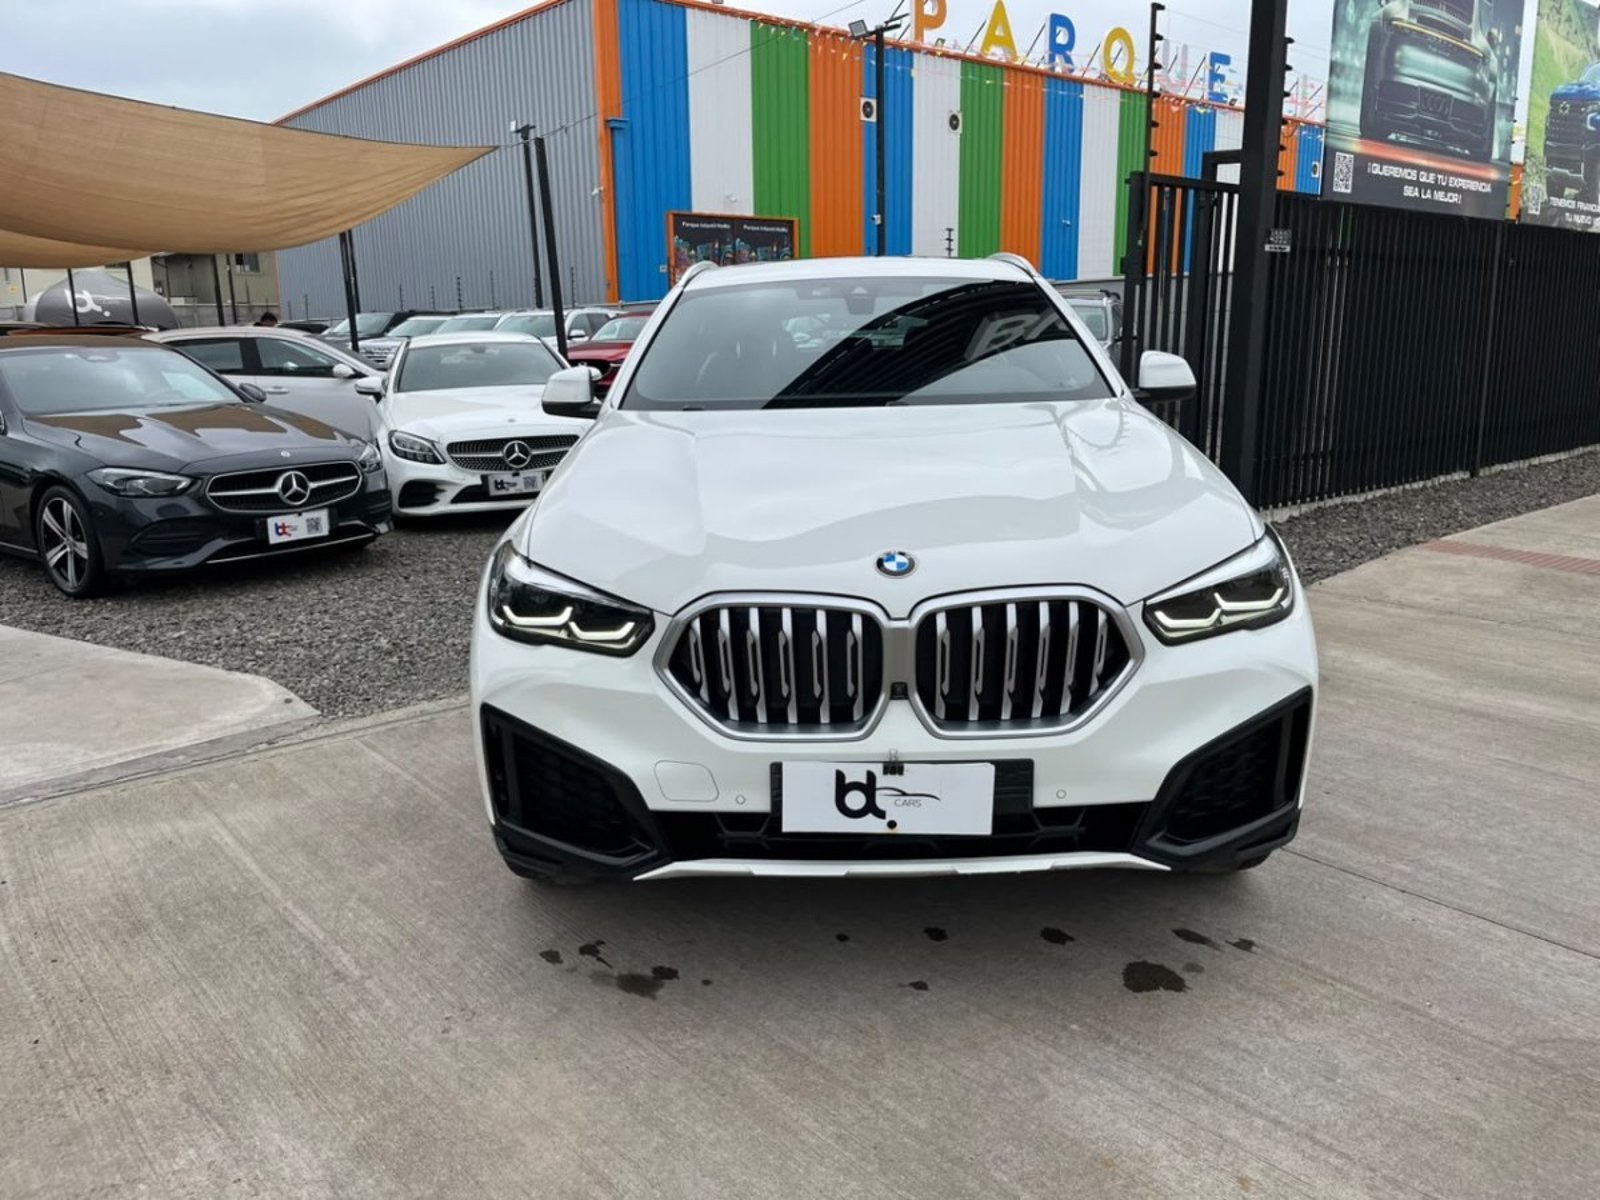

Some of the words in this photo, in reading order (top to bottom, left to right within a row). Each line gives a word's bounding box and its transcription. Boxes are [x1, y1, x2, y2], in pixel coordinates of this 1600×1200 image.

[1419, 171, 1436, 184] QUE
[1437, 174, 1448, 186] TU
[1403, 184, 1419, 198] SEA
[1420, 188, 1432, 199] LA
[894, 799, 922, 808] CARS
